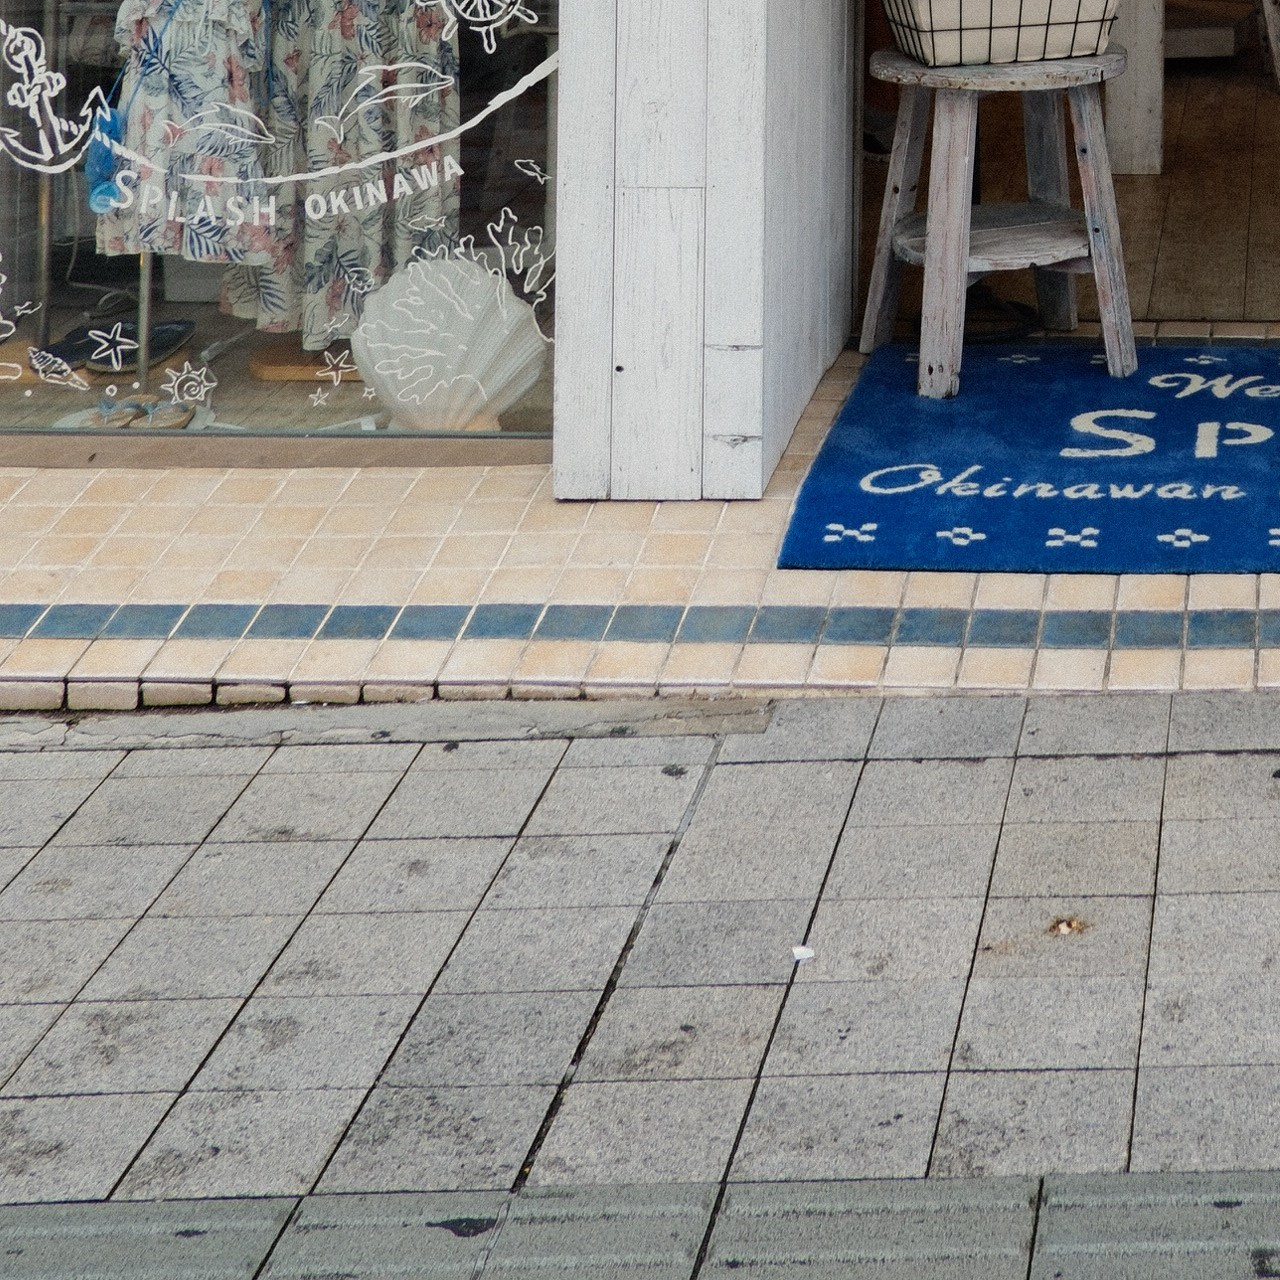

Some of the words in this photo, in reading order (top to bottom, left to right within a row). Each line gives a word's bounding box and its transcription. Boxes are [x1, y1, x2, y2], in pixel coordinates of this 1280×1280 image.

[109, 170, 277, 226] SPLASH
[304, 154, 465, 220] OKINAWA
[859, 463, 1248, 501] Okinawan
